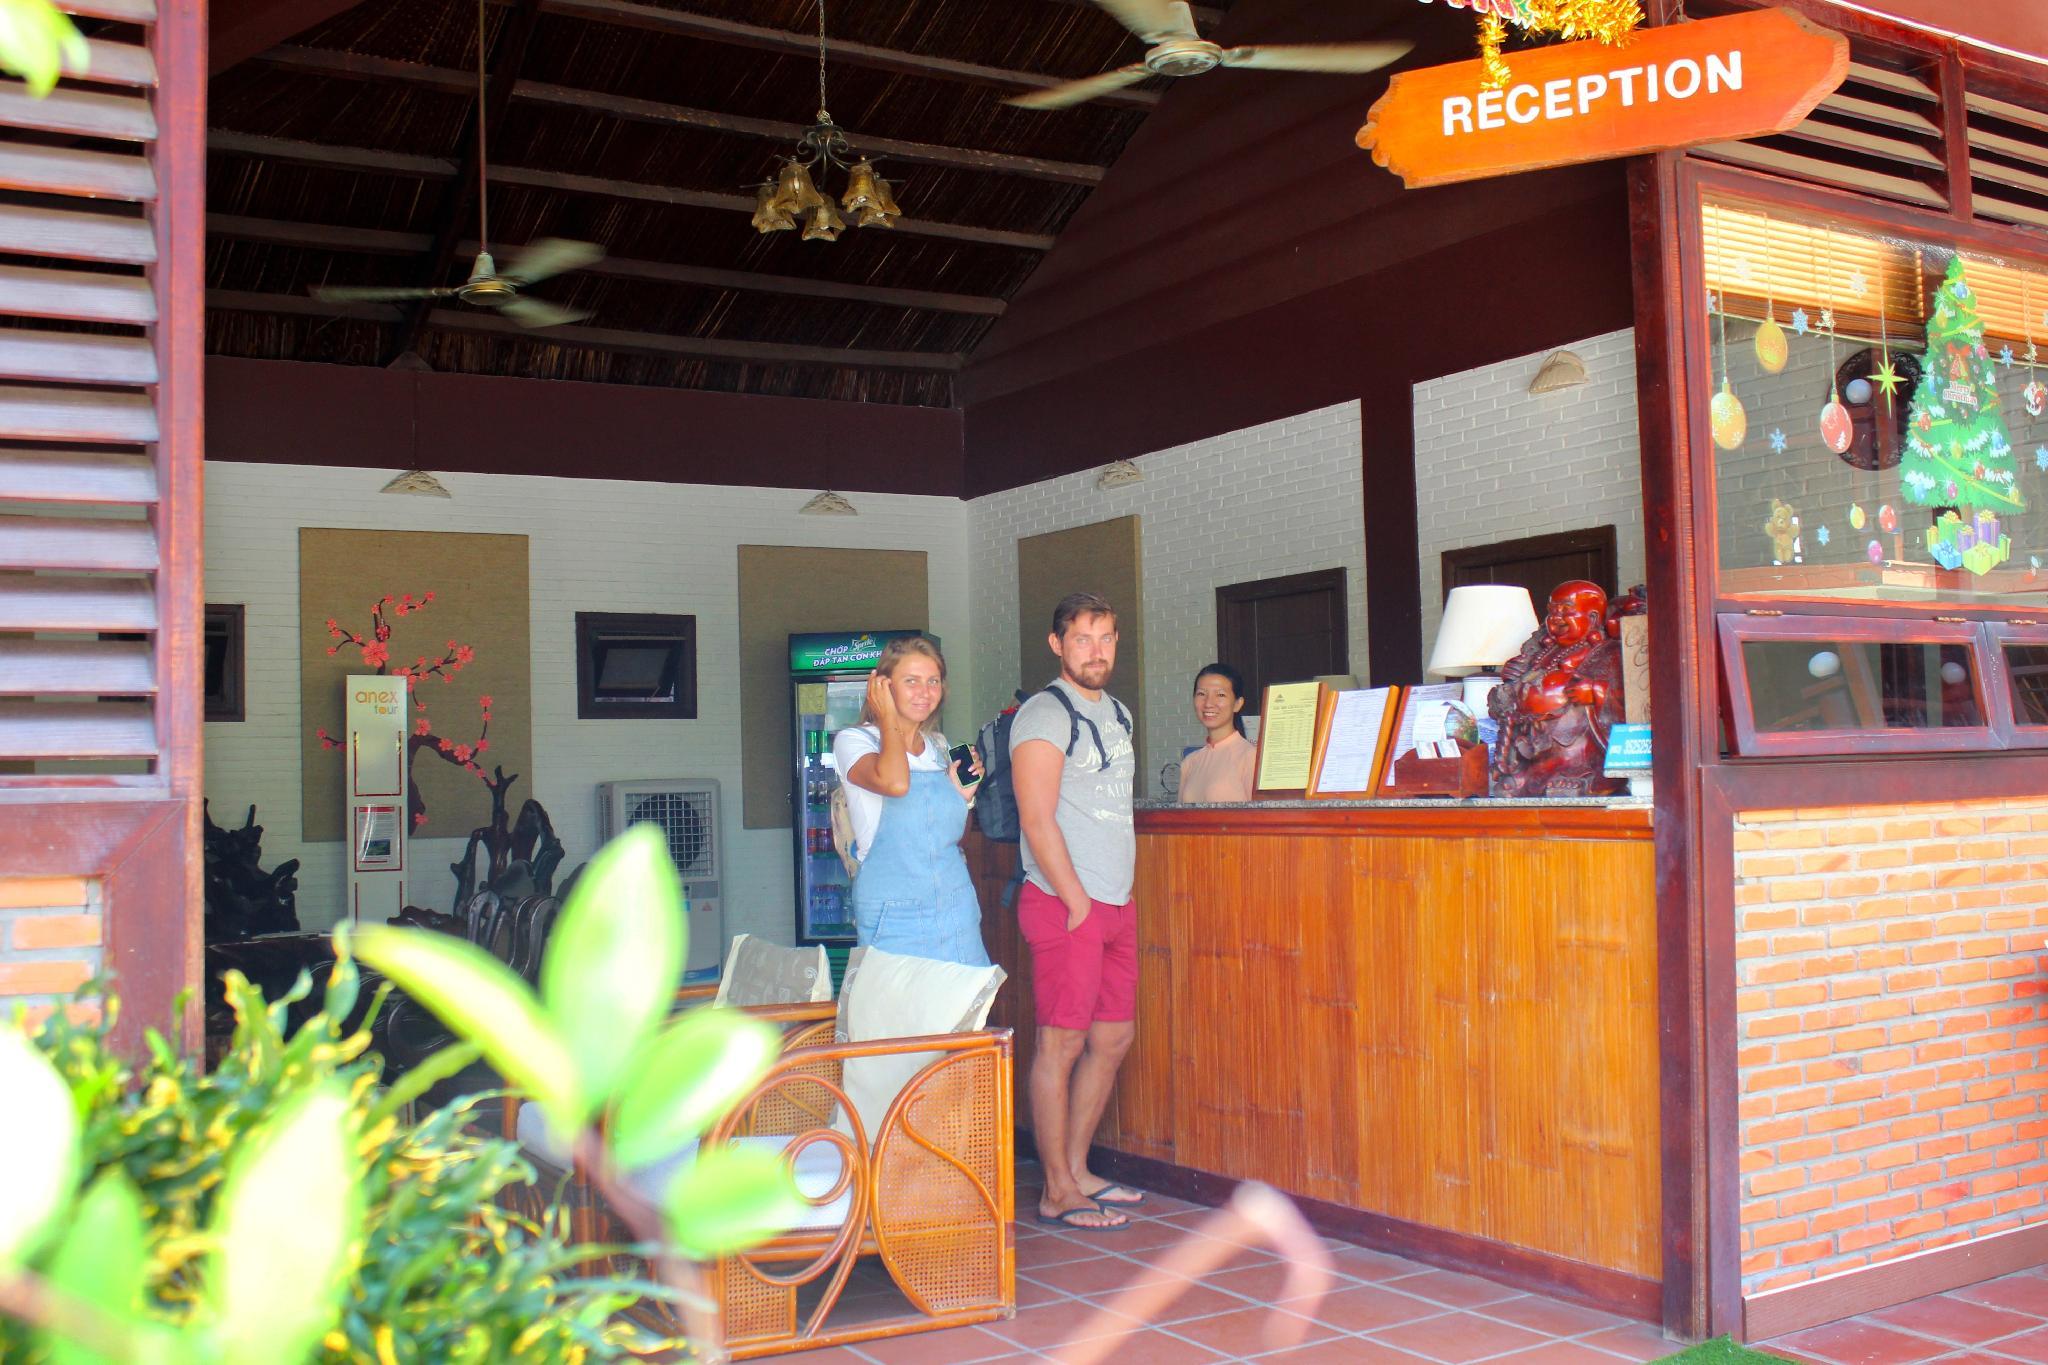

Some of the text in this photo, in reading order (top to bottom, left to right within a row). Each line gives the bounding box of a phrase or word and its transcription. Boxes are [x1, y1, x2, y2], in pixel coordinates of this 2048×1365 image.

[1442, 50, 1743, 136] RECEPTION
[854, 638, 874, 651] Sprite
[869, 650, 883, 659] KH
[355, 691, 398, 704] anex
[374, 704, 398, 715] tour
